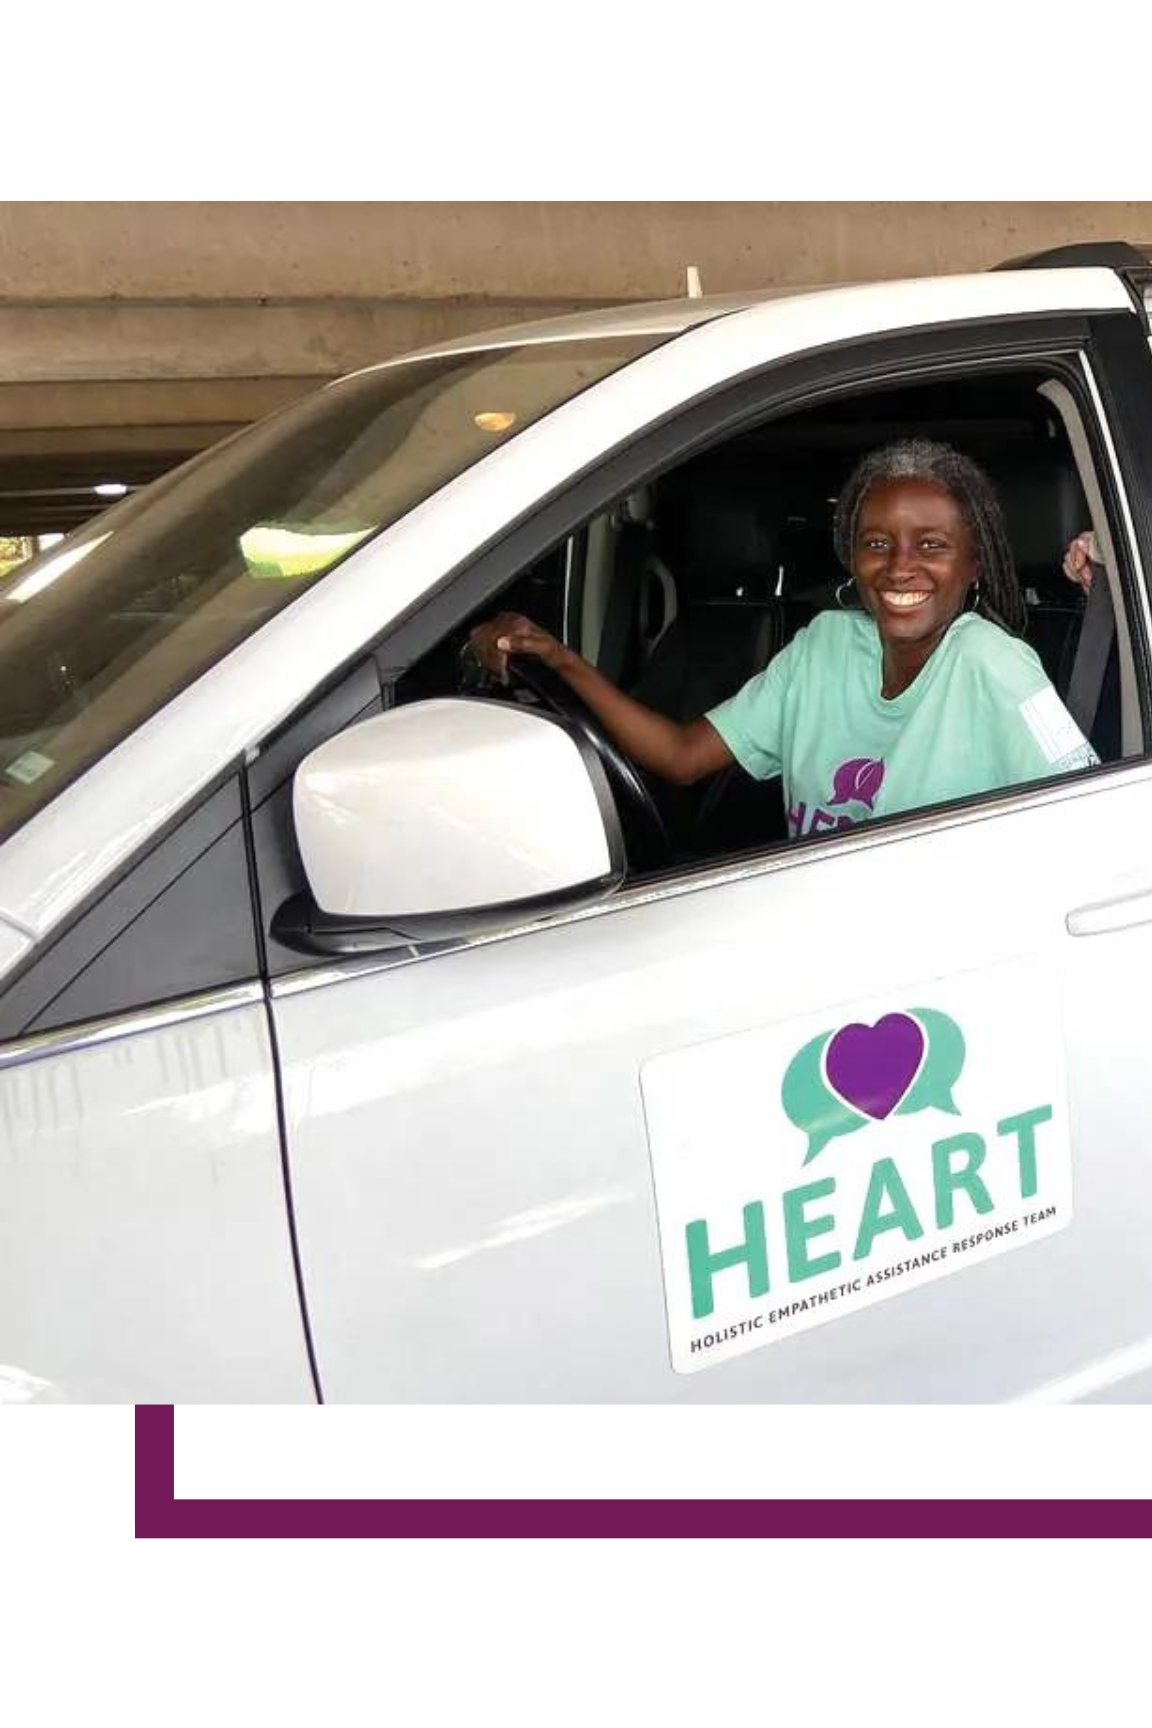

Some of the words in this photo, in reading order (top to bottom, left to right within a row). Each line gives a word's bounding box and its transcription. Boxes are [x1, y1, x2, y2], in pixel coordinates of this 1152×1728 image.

[685, 1104, 1053, 1319] HEART
[690, 1315, 764, 1353] HOLISTIC
[769, 1278, 861, 1324] EMPATHETIC
[866, 1246, 948, 1287] ASSISTANCE
[952, 1219, 1019, 1254] RESPONSE
[1023, 1205, 1057, 1227] TEAM
